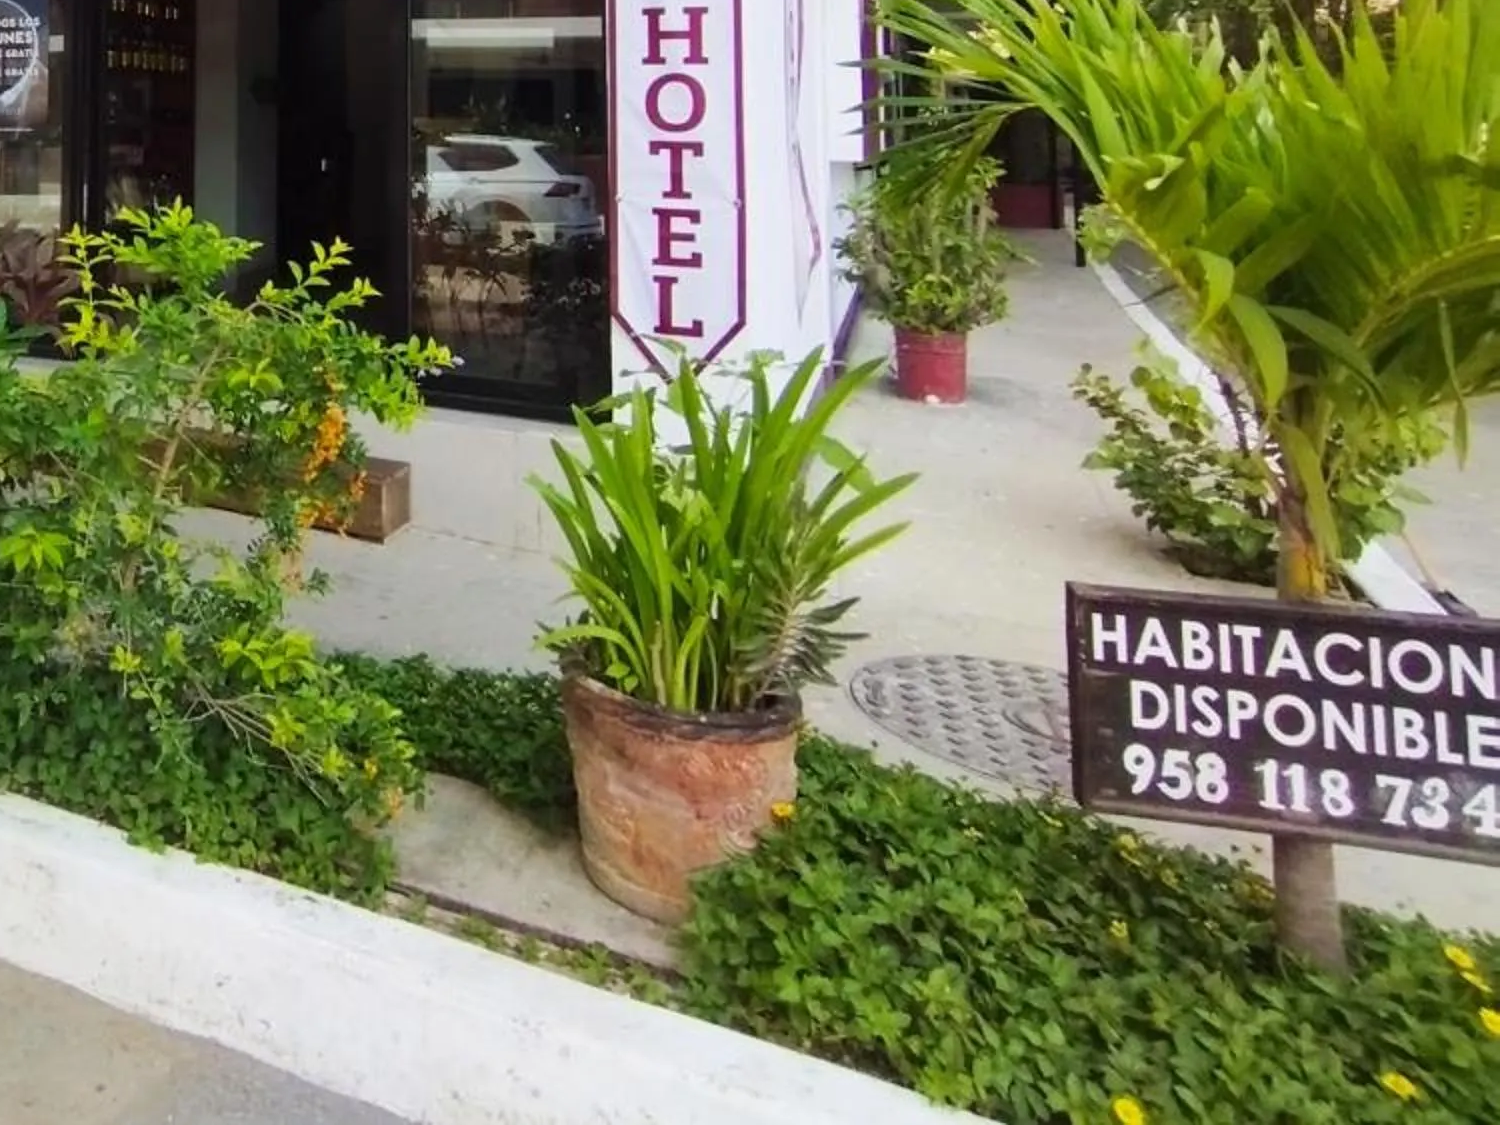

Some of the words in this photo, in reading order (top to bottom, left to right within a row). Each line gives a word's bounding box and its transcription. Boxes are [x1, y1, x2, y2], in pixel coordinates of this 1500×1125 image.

[5, 48, 38, 58] GRAT
[641, 5, 709, 338] HOTEL
[1091, 612, 1500, 701] HABITACION
[1129, 679, 1500, 769] DISPONIBLE
[1123, 743, 1229, 805] 958
[1253, 758, 1355, 818] 118
[1376, 773, 1500, 839] 734
